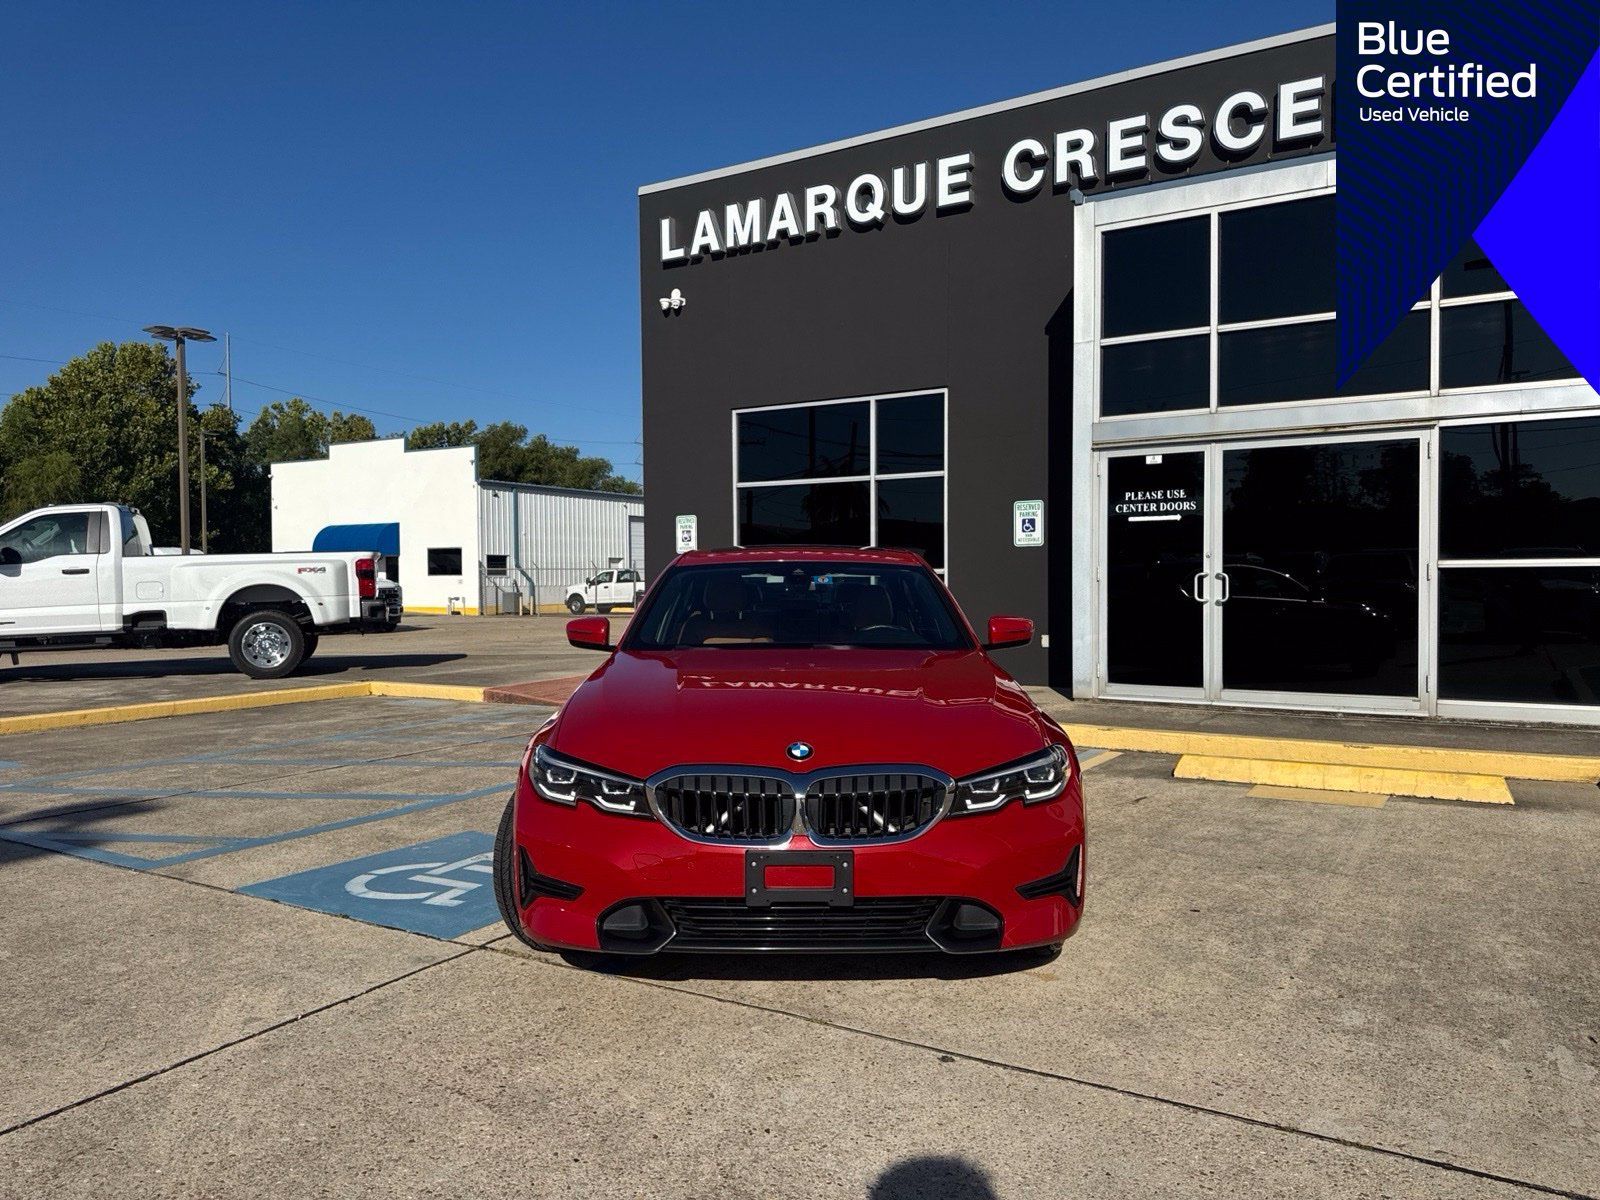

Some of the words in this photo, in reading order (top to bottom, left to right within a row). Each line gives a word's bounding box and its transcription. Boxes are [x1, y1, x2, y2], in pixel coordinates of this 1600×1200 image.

[659, 152, 973, 263] LAMARQUE
[1001, 75, 1325, 193] CRESCE
[1125, 489, 1164, 501] PLEASE
[1166, 488, 1187, 499] USE
[1115, 502, 1158, 513] CENTER
[1160, 500, 1197, 511] DOORS
[297, 566, 327, 574] FX4
